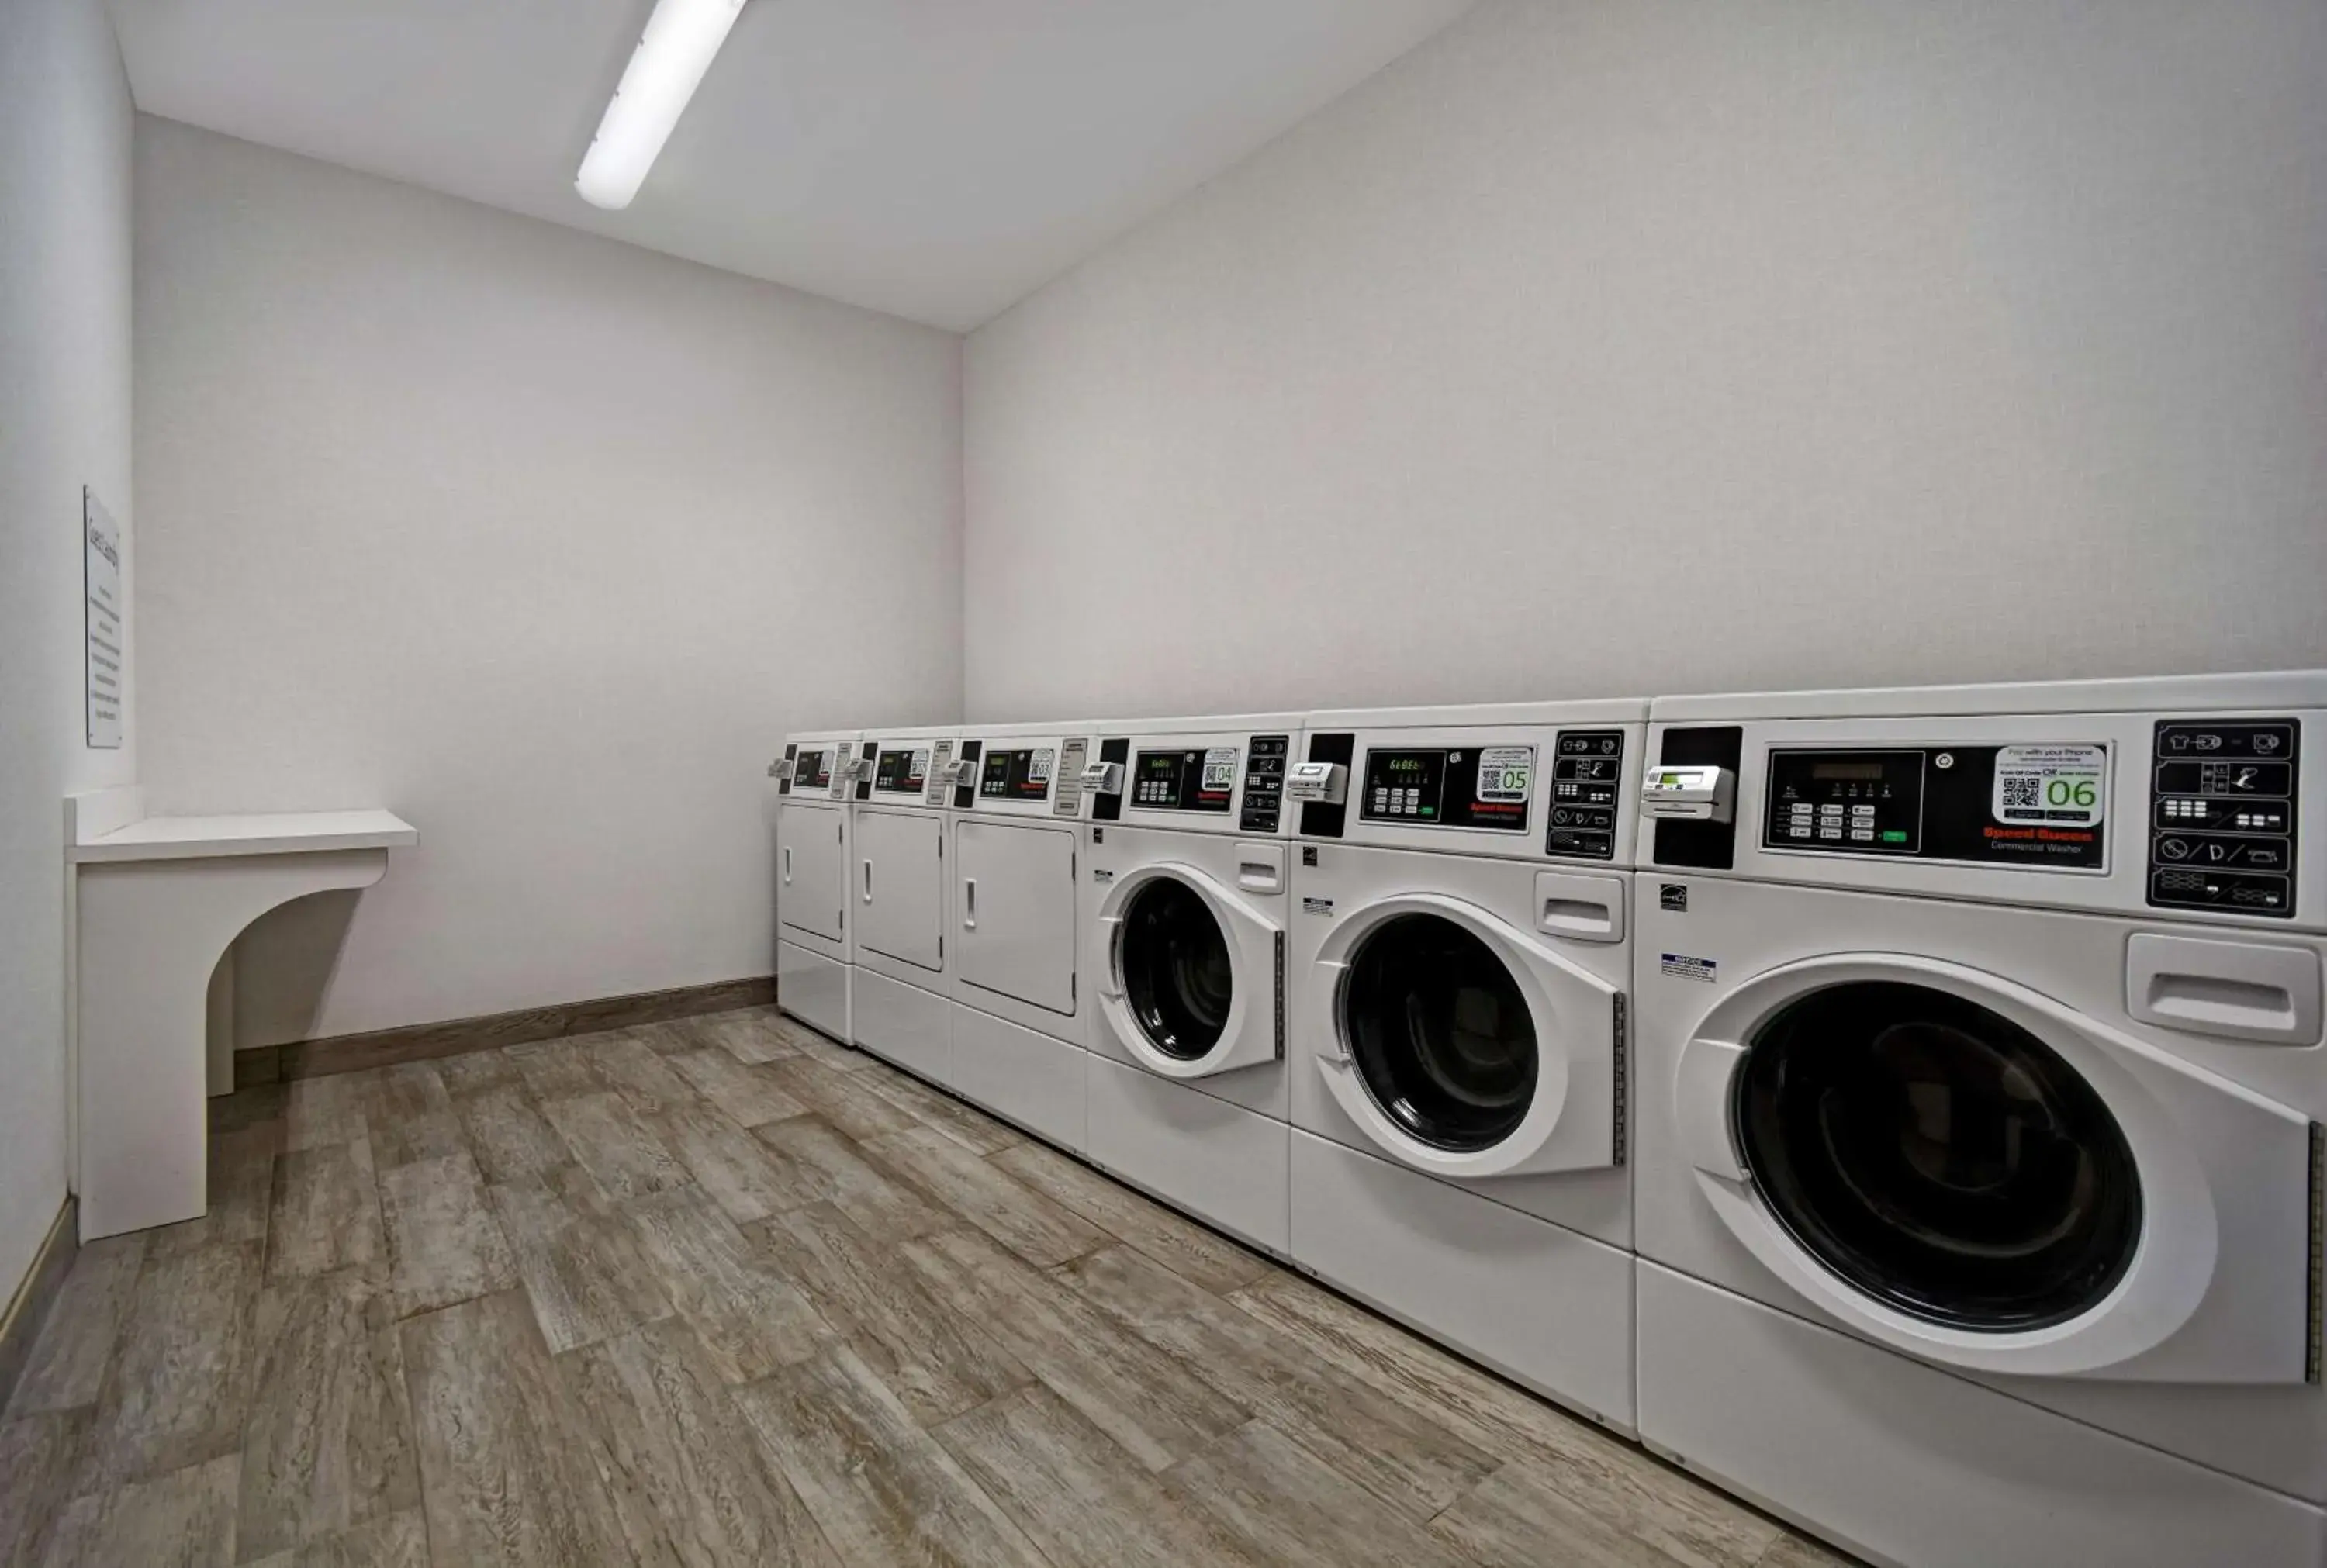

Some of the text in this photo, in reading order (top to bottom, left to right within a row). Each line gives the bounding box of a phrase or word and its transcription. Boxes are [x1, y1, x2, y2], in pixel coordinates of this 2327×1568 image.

[1217, 766, 1231, 781] 04
[1503, 771, 1527, 789] 05
[2047, 780, 2096, 807] 06
[1983, 827, 2093, 841] Speed Queen
[1991, 841, 2083, 853] Commercial Washer
